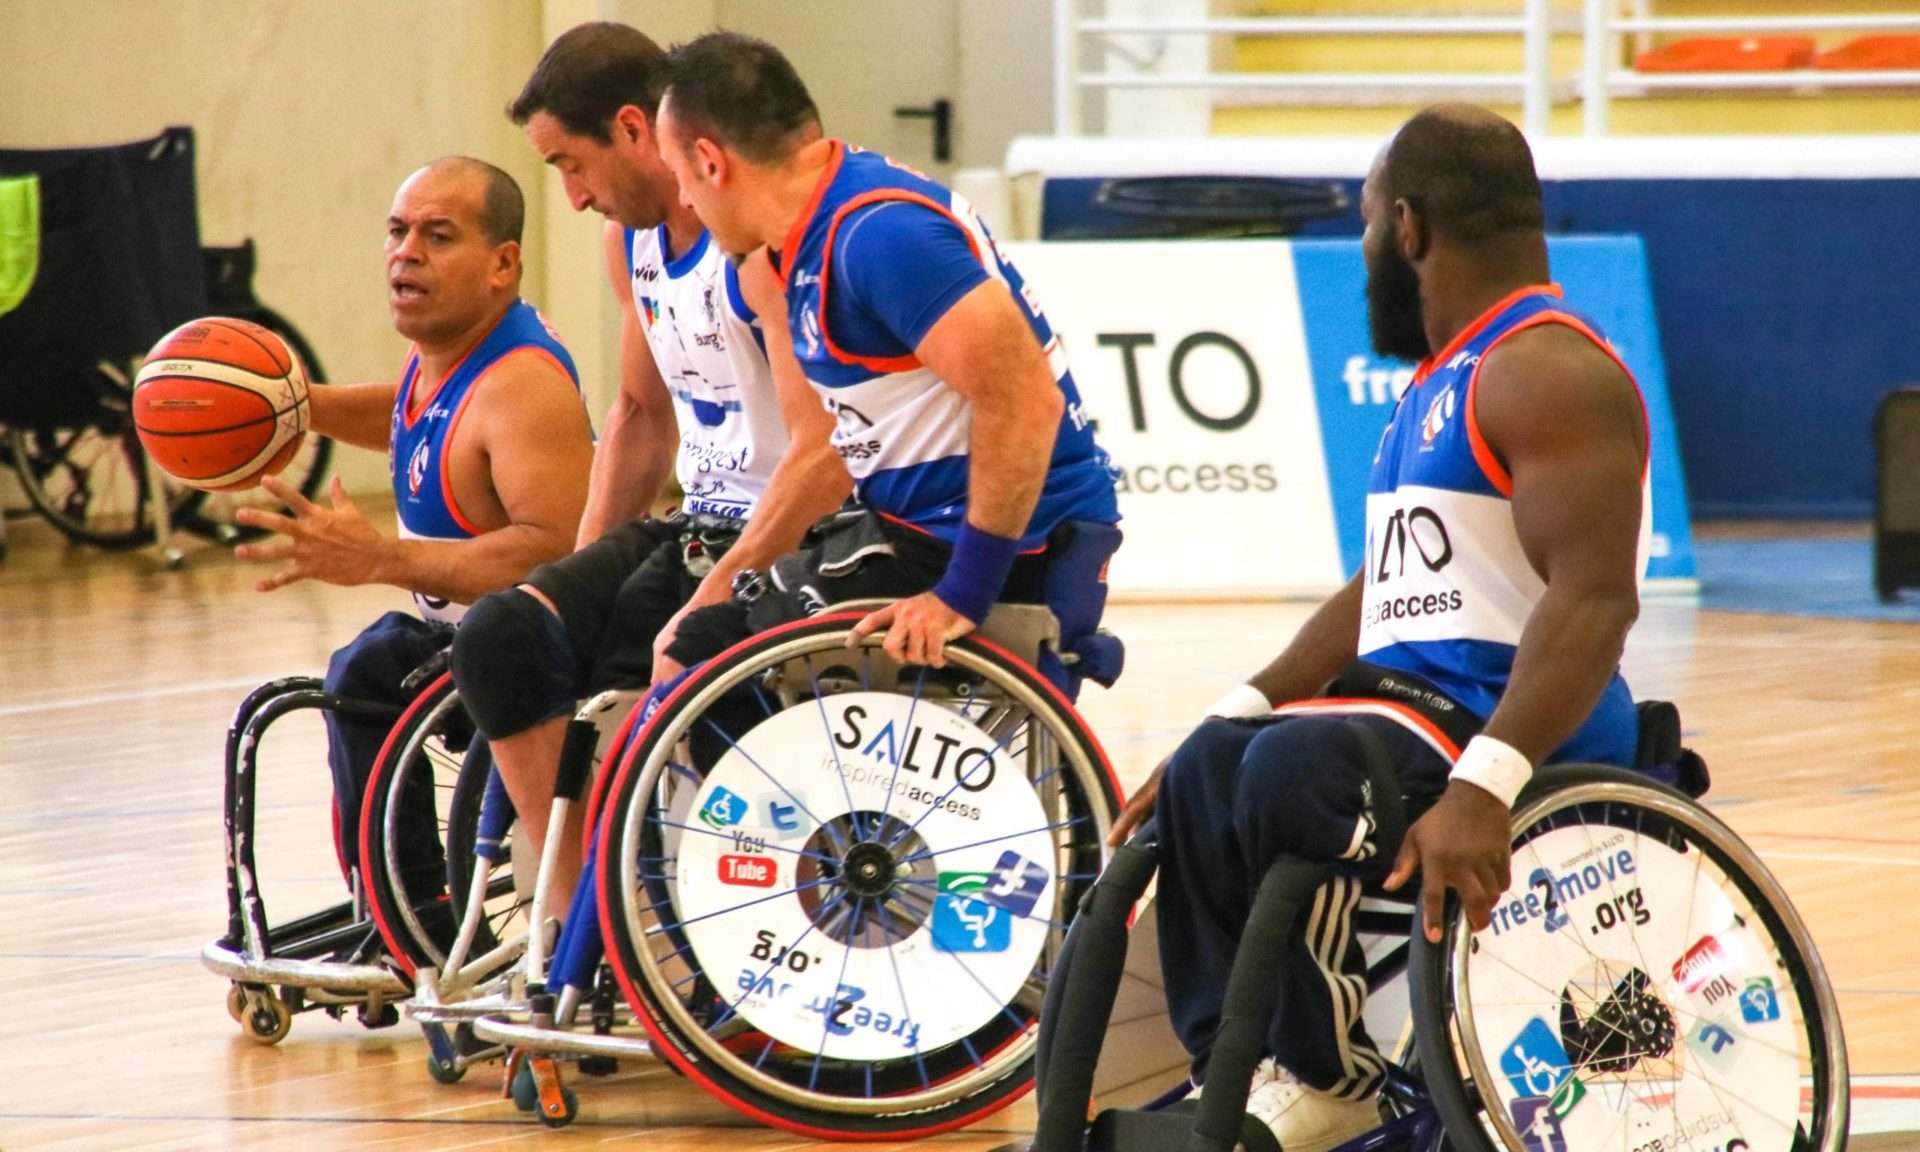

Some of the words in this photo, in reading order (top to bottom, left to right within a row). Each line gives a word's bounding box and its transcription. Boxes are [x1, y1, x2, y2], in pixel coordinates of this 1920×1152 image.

[1090, 331, 1262, 433] TO
[833, 705, 996, 793] SALTO
[733, 830, 765, 853] You
[727, 858, 767, 881] Tube
[1591, 887, 1651, 935] .org
[750, 930, 821, 973] .org
